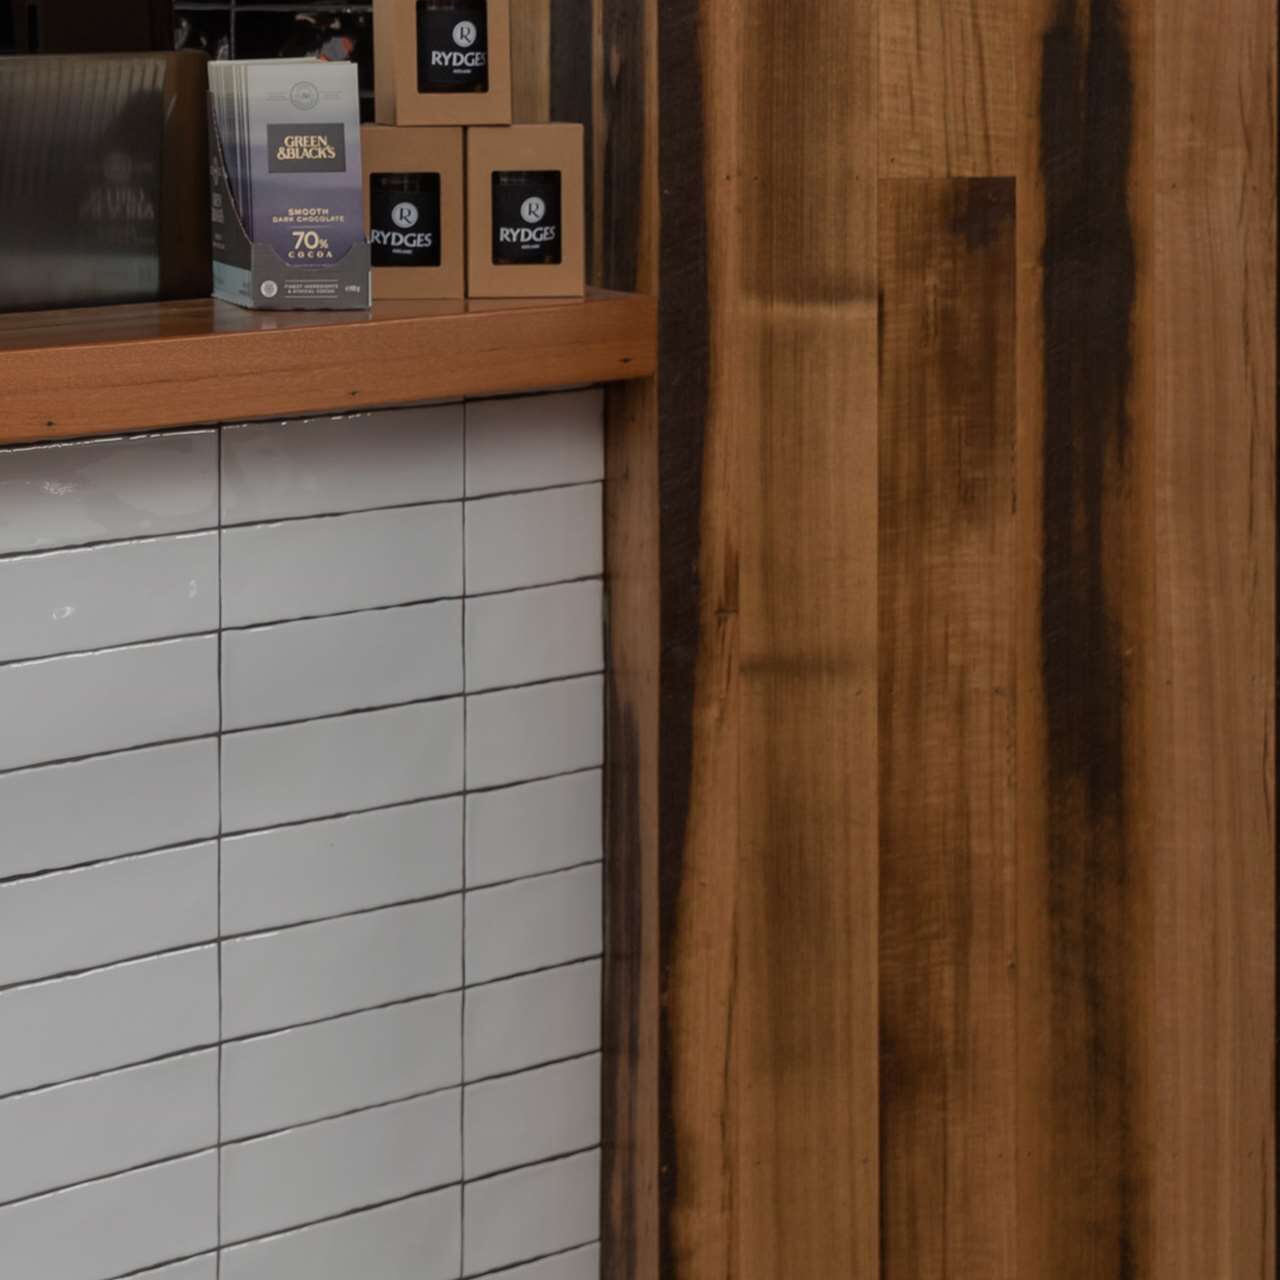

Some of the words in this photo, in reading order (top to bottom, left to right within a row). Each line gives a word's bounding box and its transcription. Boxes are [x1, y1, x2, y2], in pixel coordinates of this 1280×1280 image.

[431, 50, 486, 66] RYDGES
[284, 135, 328, 147] GREEN
[276, 145, 336, 160] &BLACK'S
[370, 229, 432, 248] RYDGES
[499, 226, 556, 242] RYDGES
[288, 250, 333, 259] COCOA
